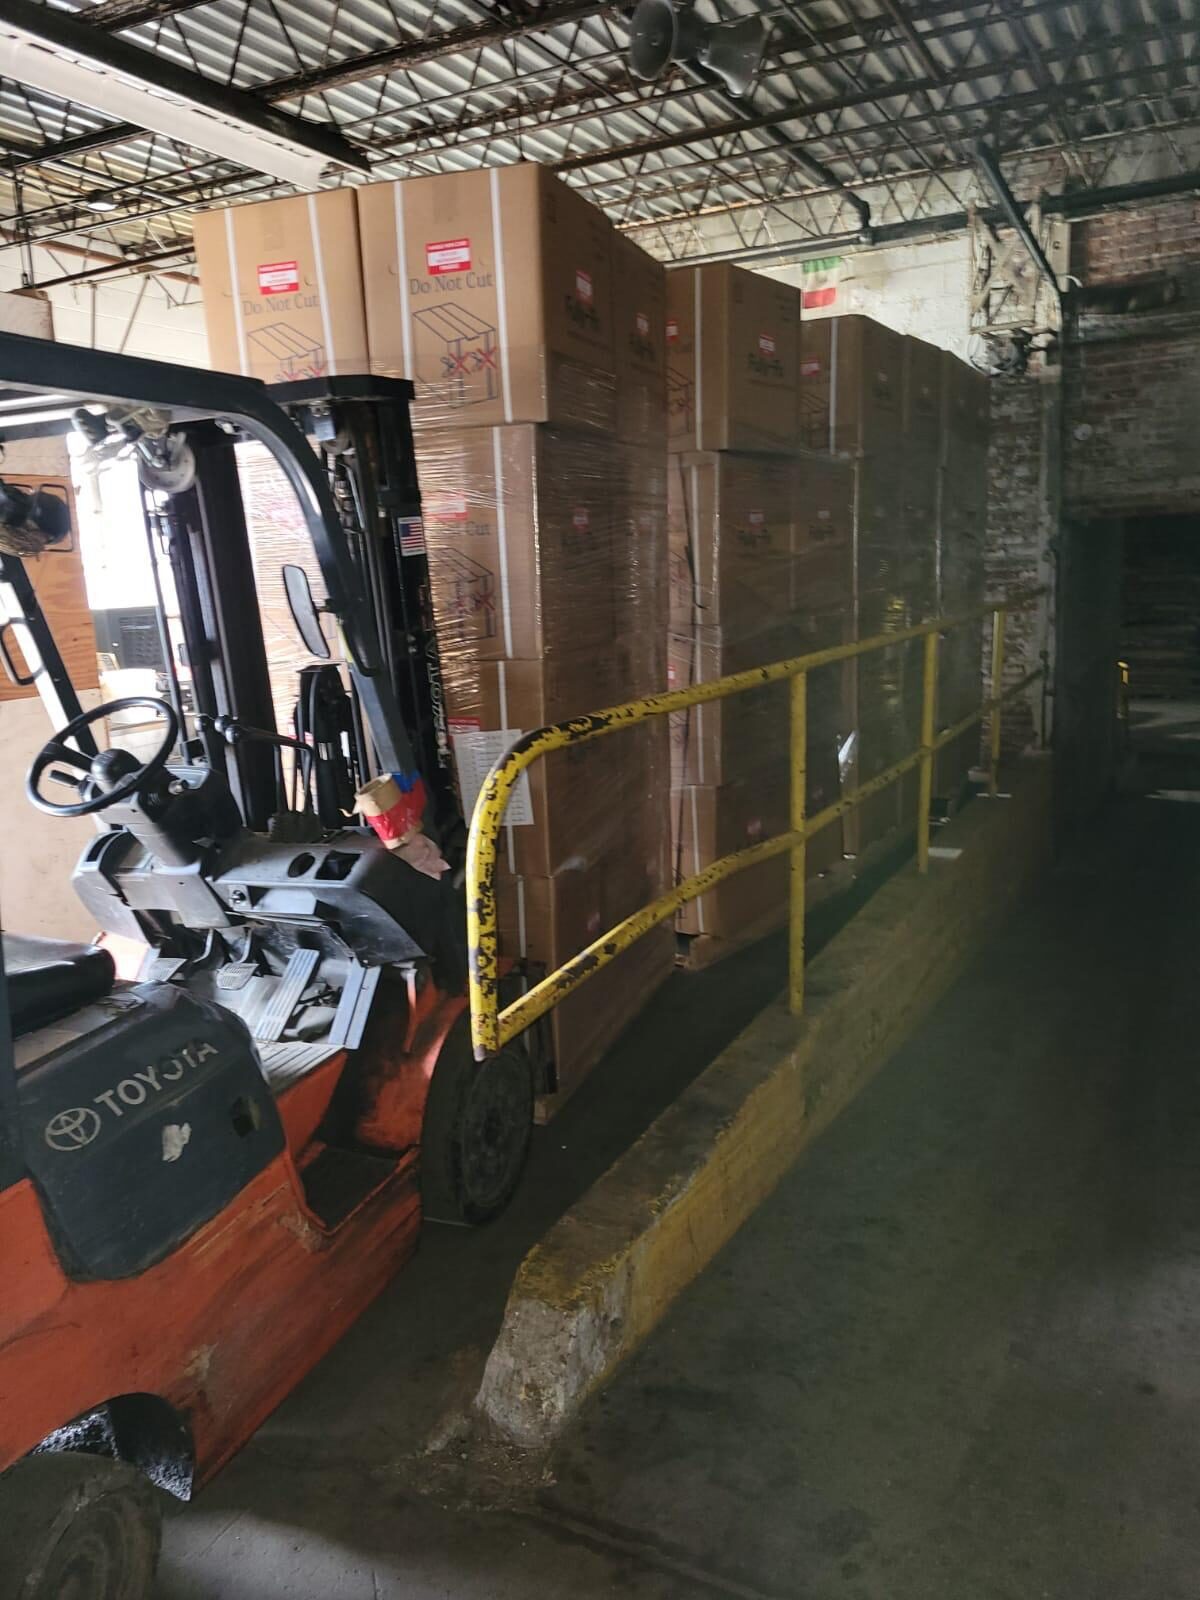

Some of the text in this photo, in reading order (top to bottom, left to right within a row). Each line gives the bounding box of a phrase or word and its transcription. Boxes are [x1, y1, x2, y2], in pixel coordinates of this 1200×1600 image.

[409, 271, 493, 295] Do Not Cut
[242, 293, 321, 317] Do Not Cut
